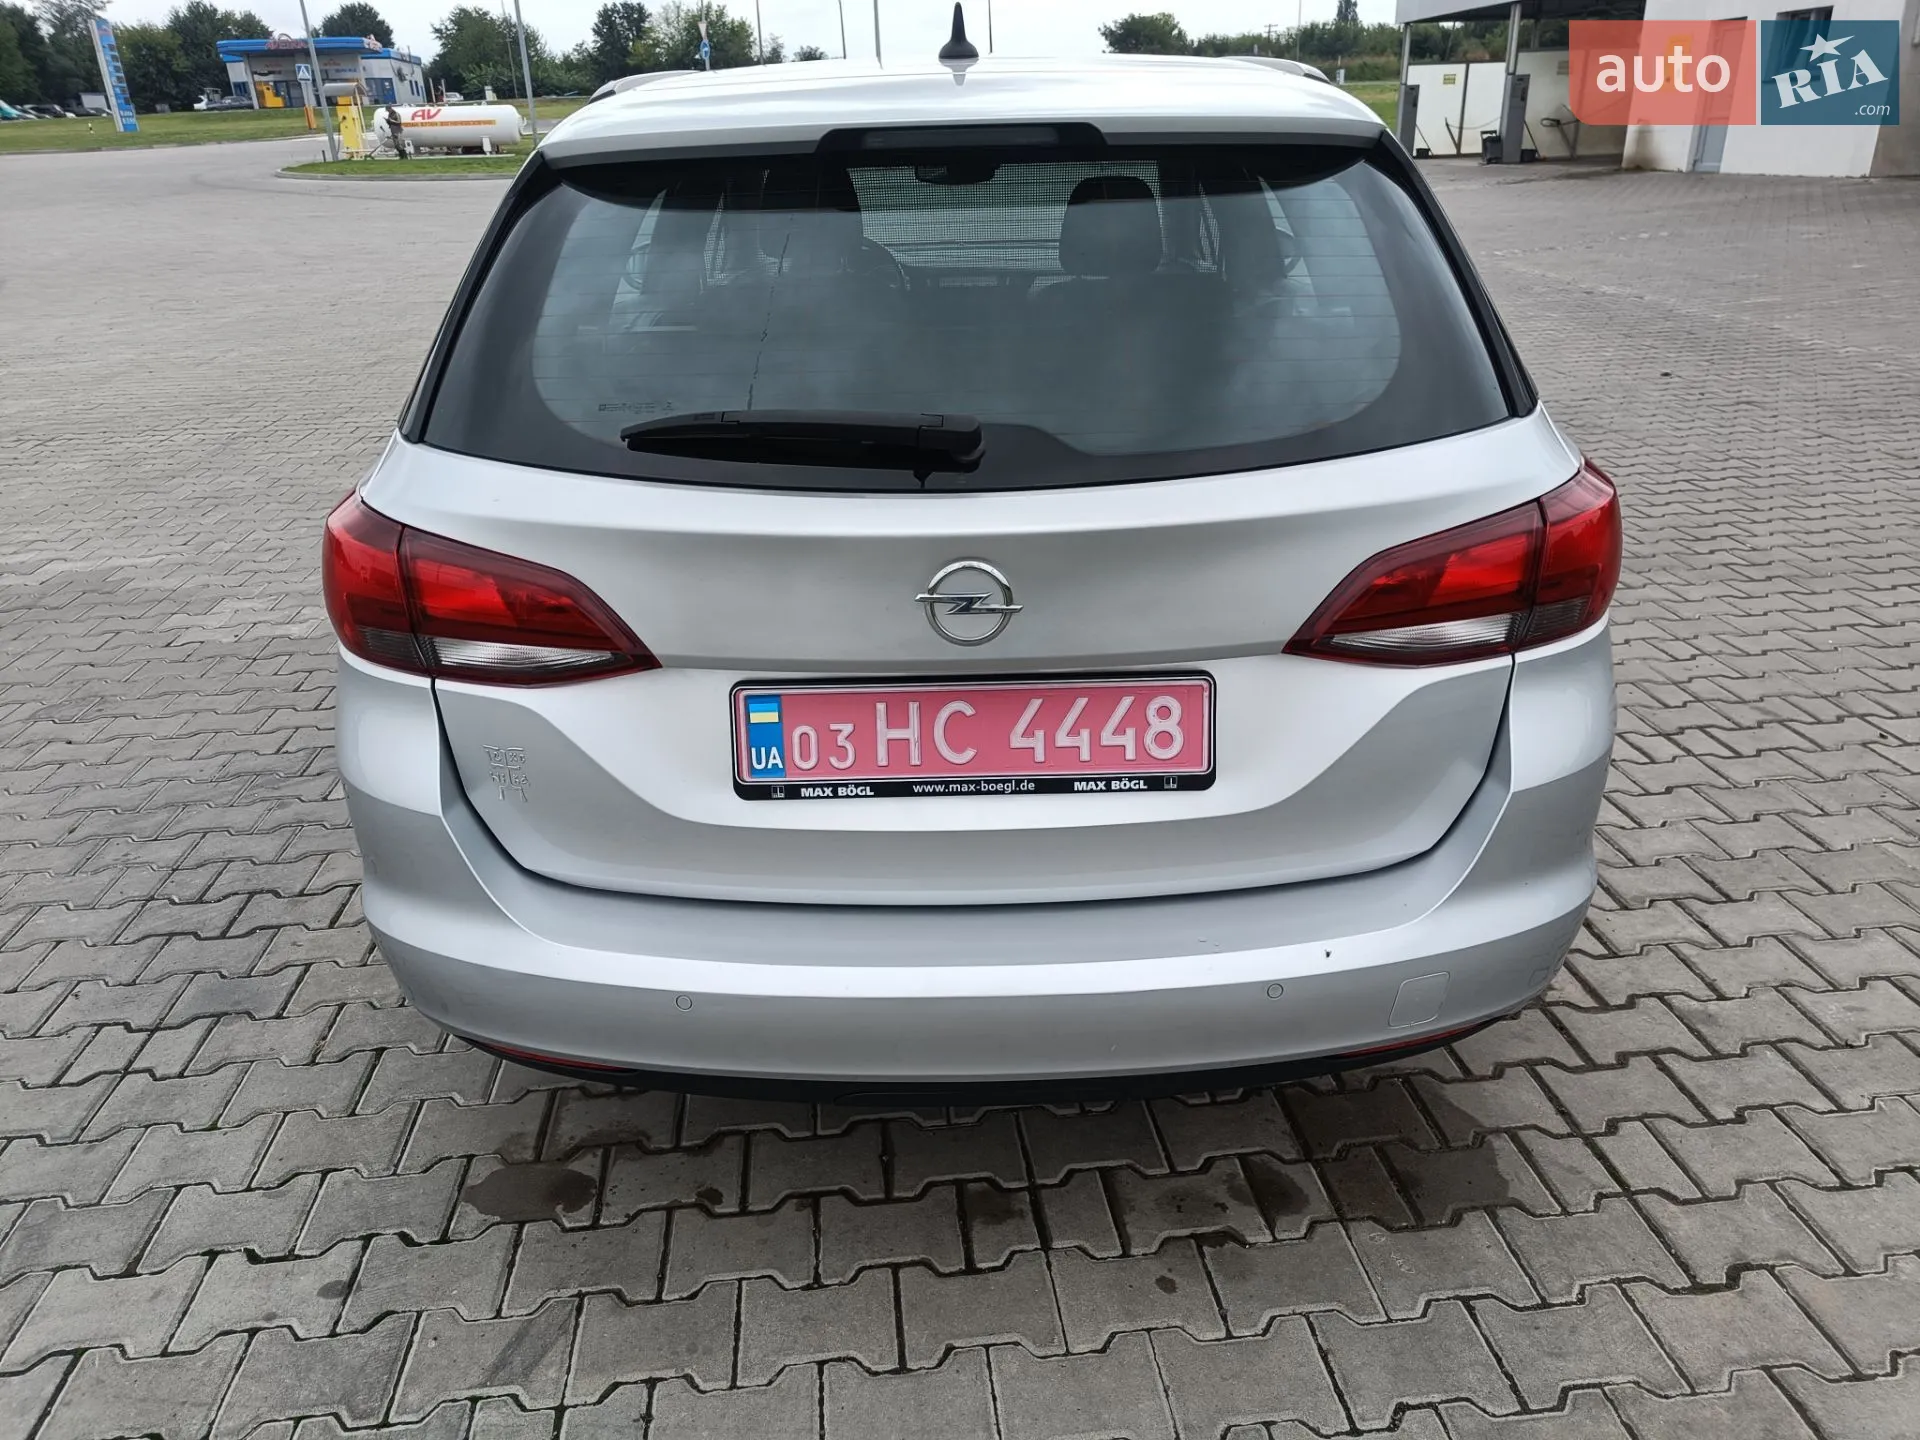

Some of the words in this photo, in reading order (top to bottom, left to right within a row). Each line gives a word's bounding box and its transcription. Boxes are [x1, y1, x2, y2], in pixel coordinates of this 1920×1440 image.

[411, 108, 442, 121] AV
[791, 723, 856, 770] 03
[875, 700, 978, 767] HC
[1009, 695, 1184, 763] 4448
[751, 746, 784, 770] UA
[800, 787, 834, 797] MAX
[837, 784, 875, 797] BÖGL
[912, 779, 1036, 796] www.max-boegl.de
[1073, 781, 1106, 791] MAX
[1110, 777, 1148, 790] BÖGL
